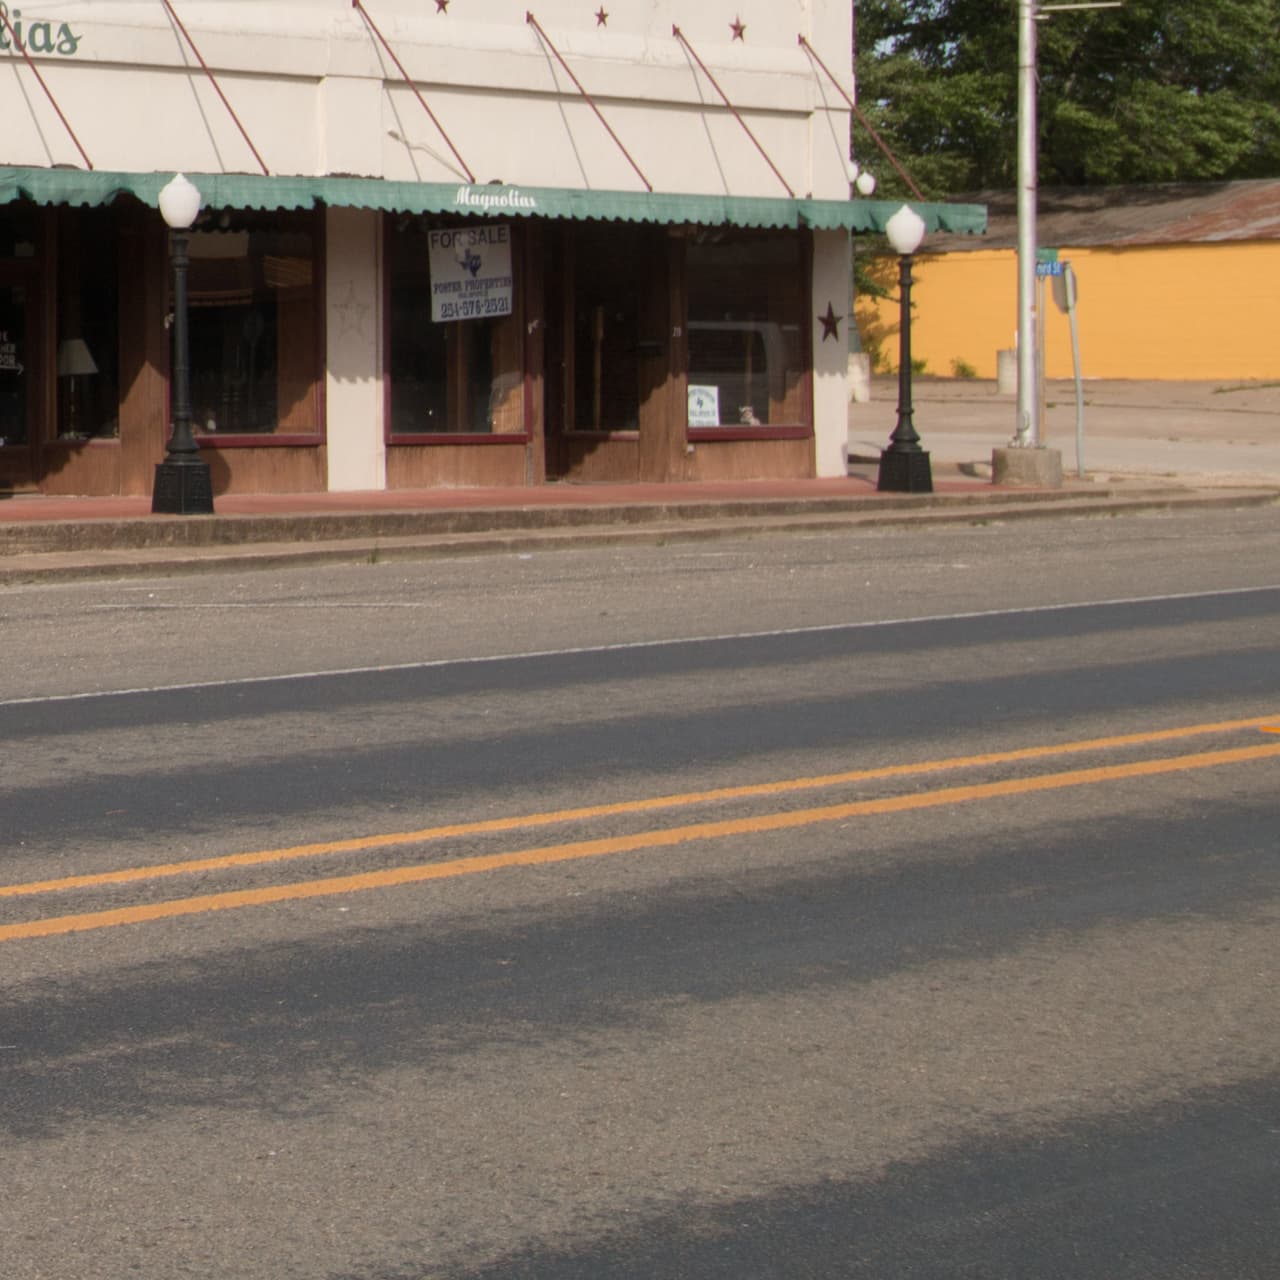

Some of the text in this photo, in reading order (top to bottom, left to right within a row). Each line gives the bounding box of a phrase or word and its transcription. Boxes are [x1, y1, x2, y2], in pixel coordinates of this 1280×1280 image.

[453, 186, 537, 211] Magnolias
[430, 226, 508, 249] FOR SALE
